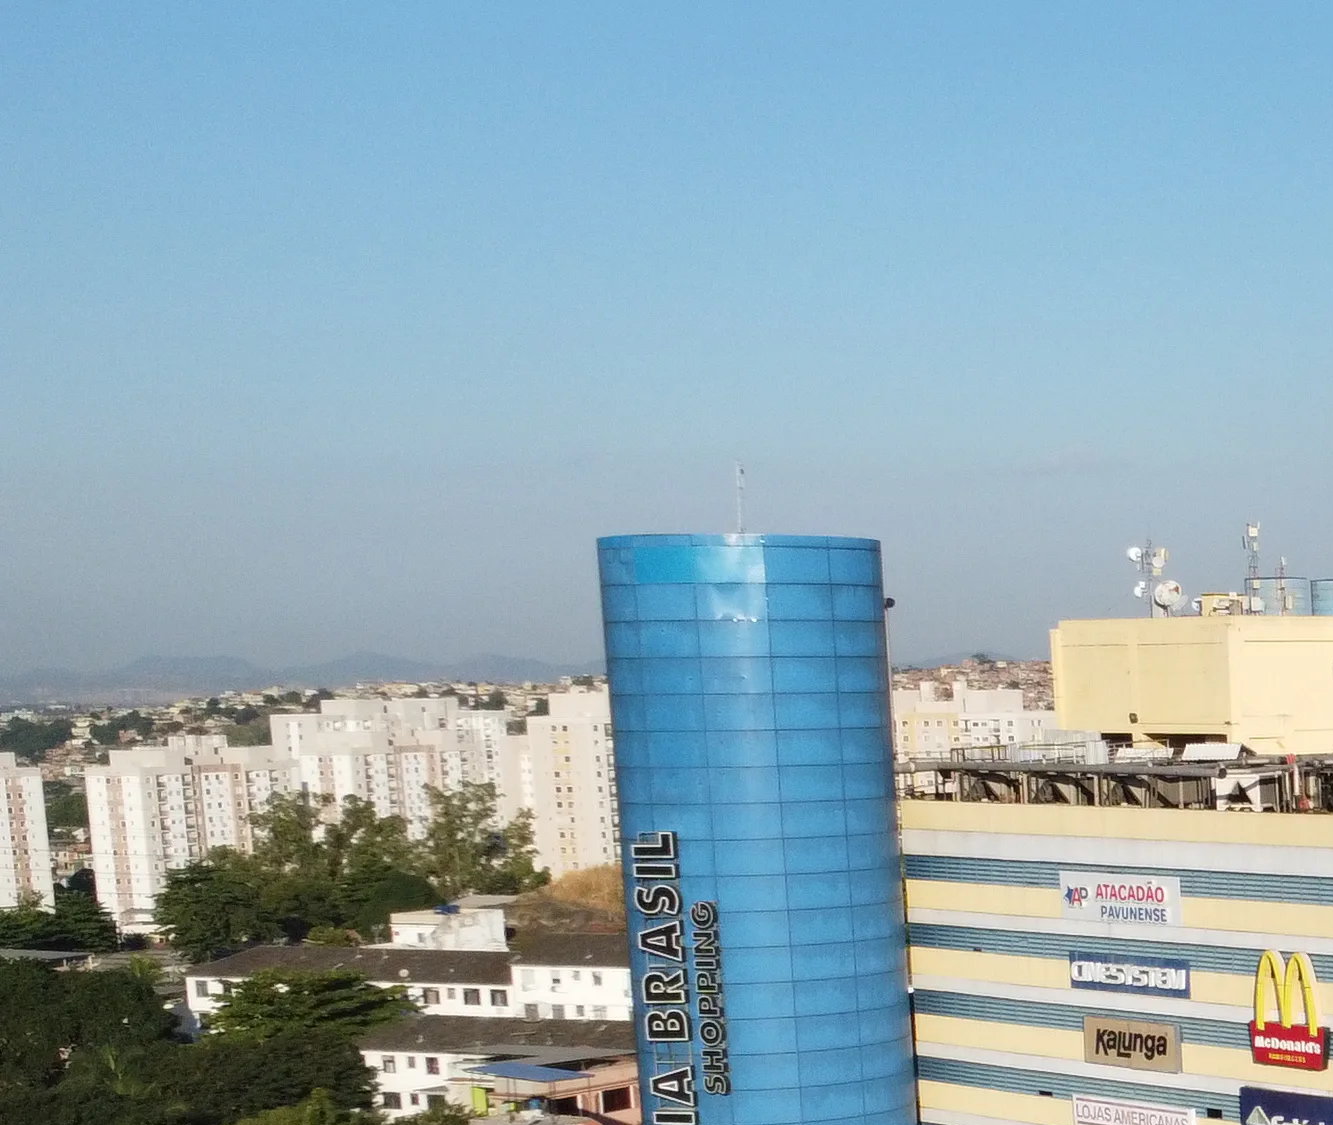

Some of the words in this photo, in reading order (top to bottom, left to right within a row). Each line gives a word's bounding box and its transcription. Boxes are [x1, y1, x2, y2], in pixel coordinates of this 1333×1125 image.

[1095, 880, 1165, 903] ATACADÃO
[1100, 905, 1168, 922] PAVUNENSE
[632, 831, 691, 1042] BRASIL
[1071, 961, 1187, 990] CINESYSTEM
[690, 900, 731, 1096] SHOPPING
[1254, 1035, 1321, 1054] McDonald's
[1076, 1103, 1112, 1121] LOJAS
